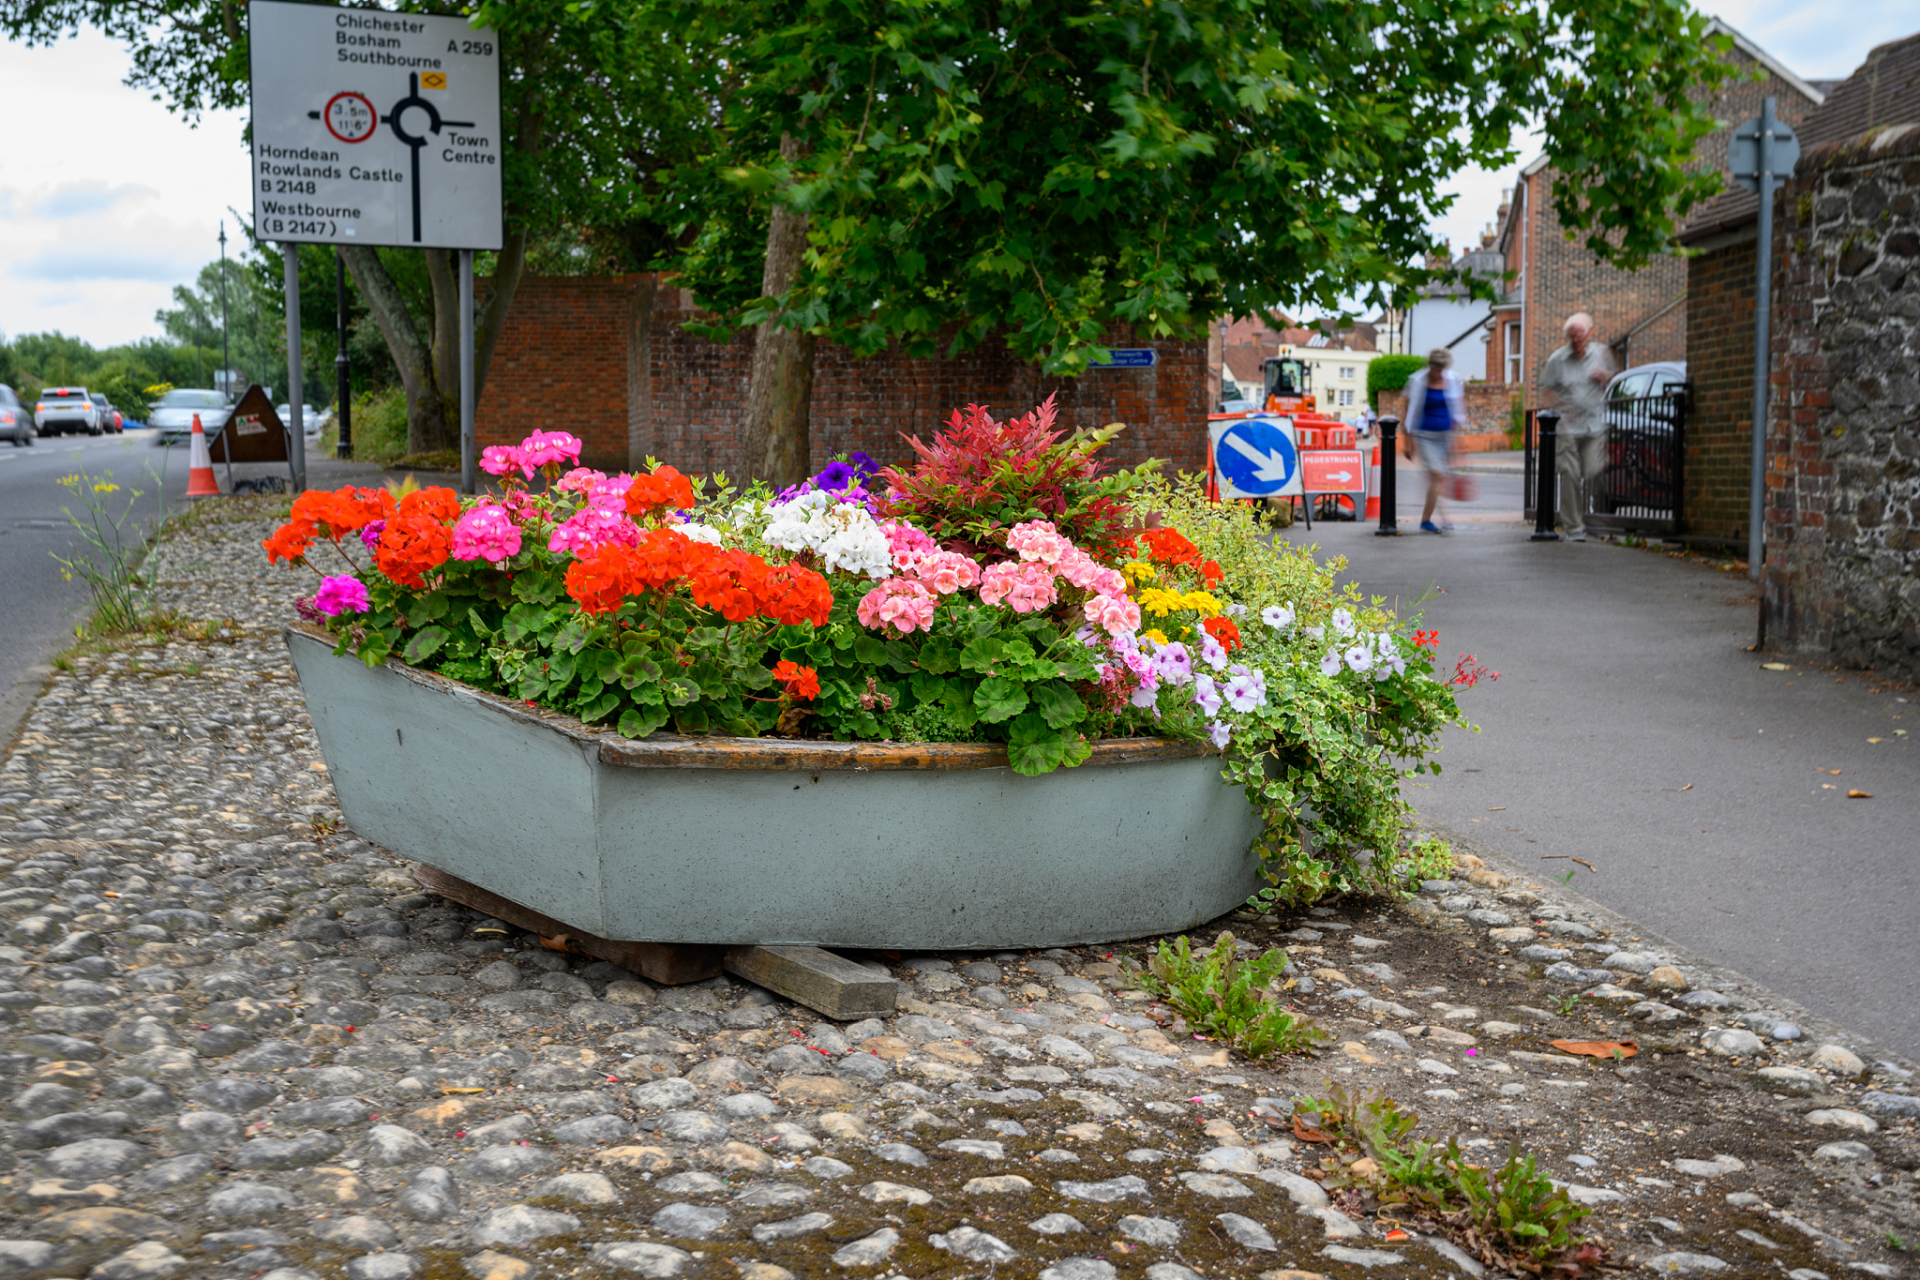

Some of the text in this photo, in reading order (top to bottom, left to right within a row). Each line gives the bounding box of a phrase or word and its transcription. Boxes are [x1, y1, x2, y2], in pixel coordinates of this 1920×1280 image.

[336, 14, 425, 34] Chichester
[336, 31, 401, 49] Bosham
[447, 40, 494, 56] A 259
[337, 49, 442, 69] Southbourne
[448, 133, 489, 147] Town
[260, 145, 339, 162] Horndean
[442, 149, 496, 165] Centre
[260, 162, 403, 182] Rowlands Castle
[261, 180, 316, 195] B 2148
[262, 201, 361, 219] Westbourne
[1304, 456, 1359, 464] PEDESTRIANS
